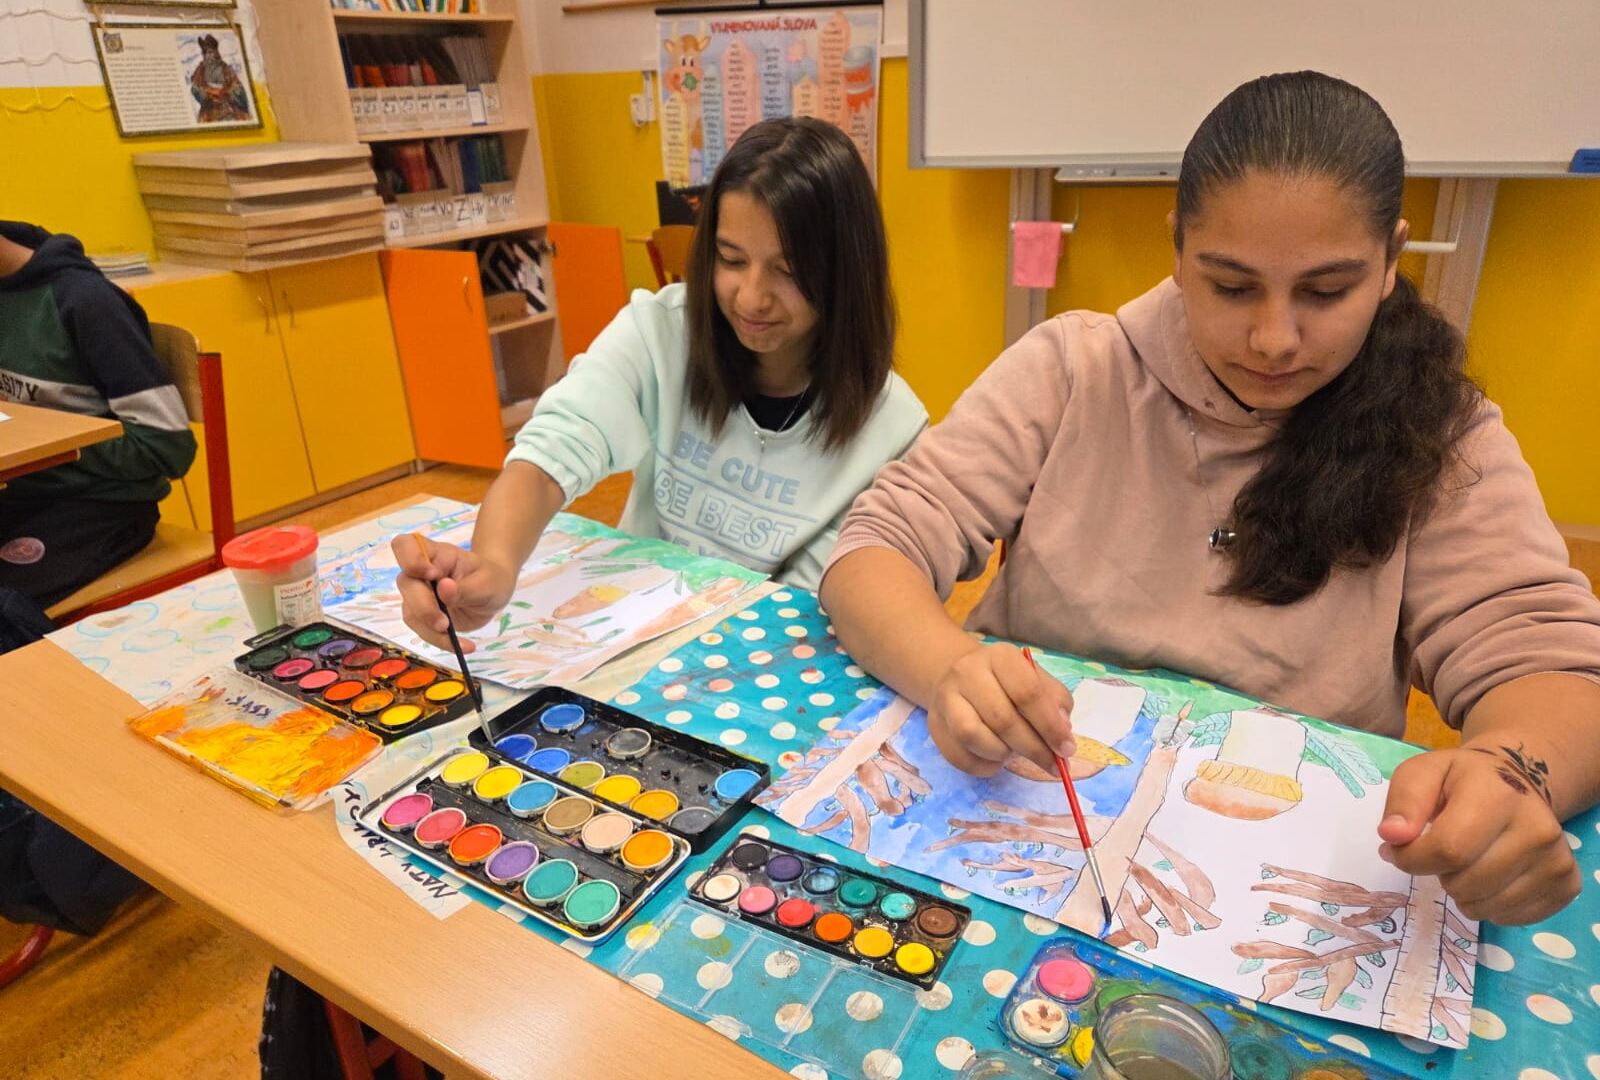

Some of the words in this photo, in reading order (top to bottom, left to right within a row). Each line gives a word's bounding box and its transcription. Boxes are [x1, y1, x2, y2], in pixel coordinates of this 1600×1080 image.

[783, 18, 817, 31] SLOVA
[0, 373, 39, 401] SITY
[673, 431, 714, 470] BE
[720, 457, 800, 505] CUTE
[655, 468, 694, 519] BE
[696, 494, 796, 557] BEST
